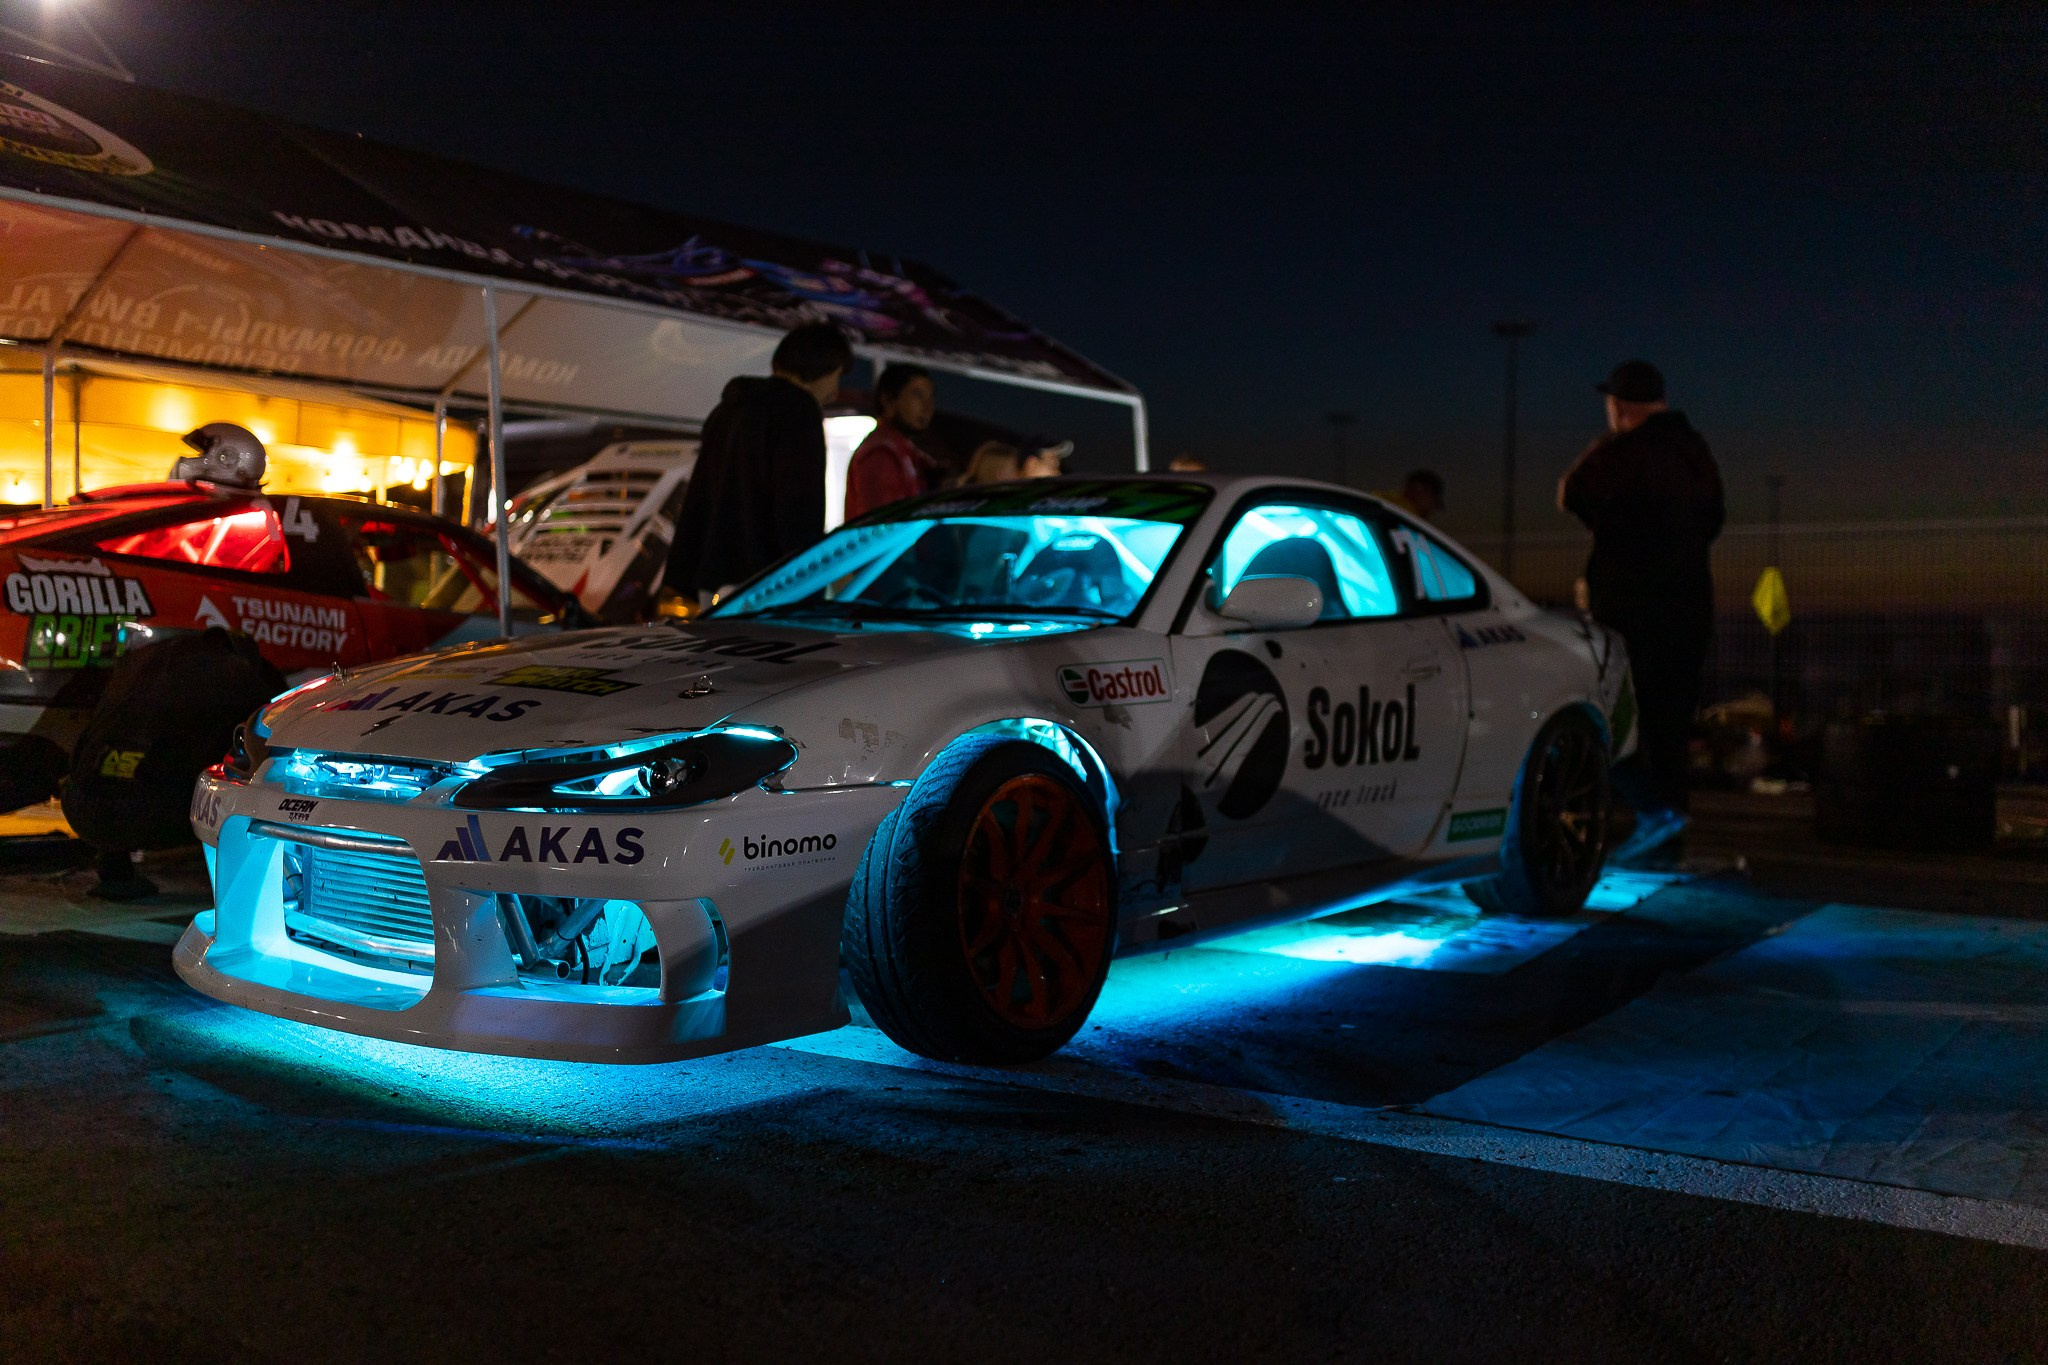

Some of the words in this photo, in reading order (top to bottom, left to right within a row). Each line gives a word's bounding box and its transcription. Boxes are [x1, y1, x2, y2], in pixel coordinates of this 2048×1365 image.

[6, 572, 152, 616] GORILLA
[233, 596, 346, 627] TSUNAMI
[241, 619, 348, 653] FACTORY
[1088, 665, 1166, 701] Castrol
[377, 691, 542, 722] AKAS
[278, 799, 320, 812] OCEAN
[499, 826, 645, 864] AKAS
[744, 834, 837, 859] binomo
